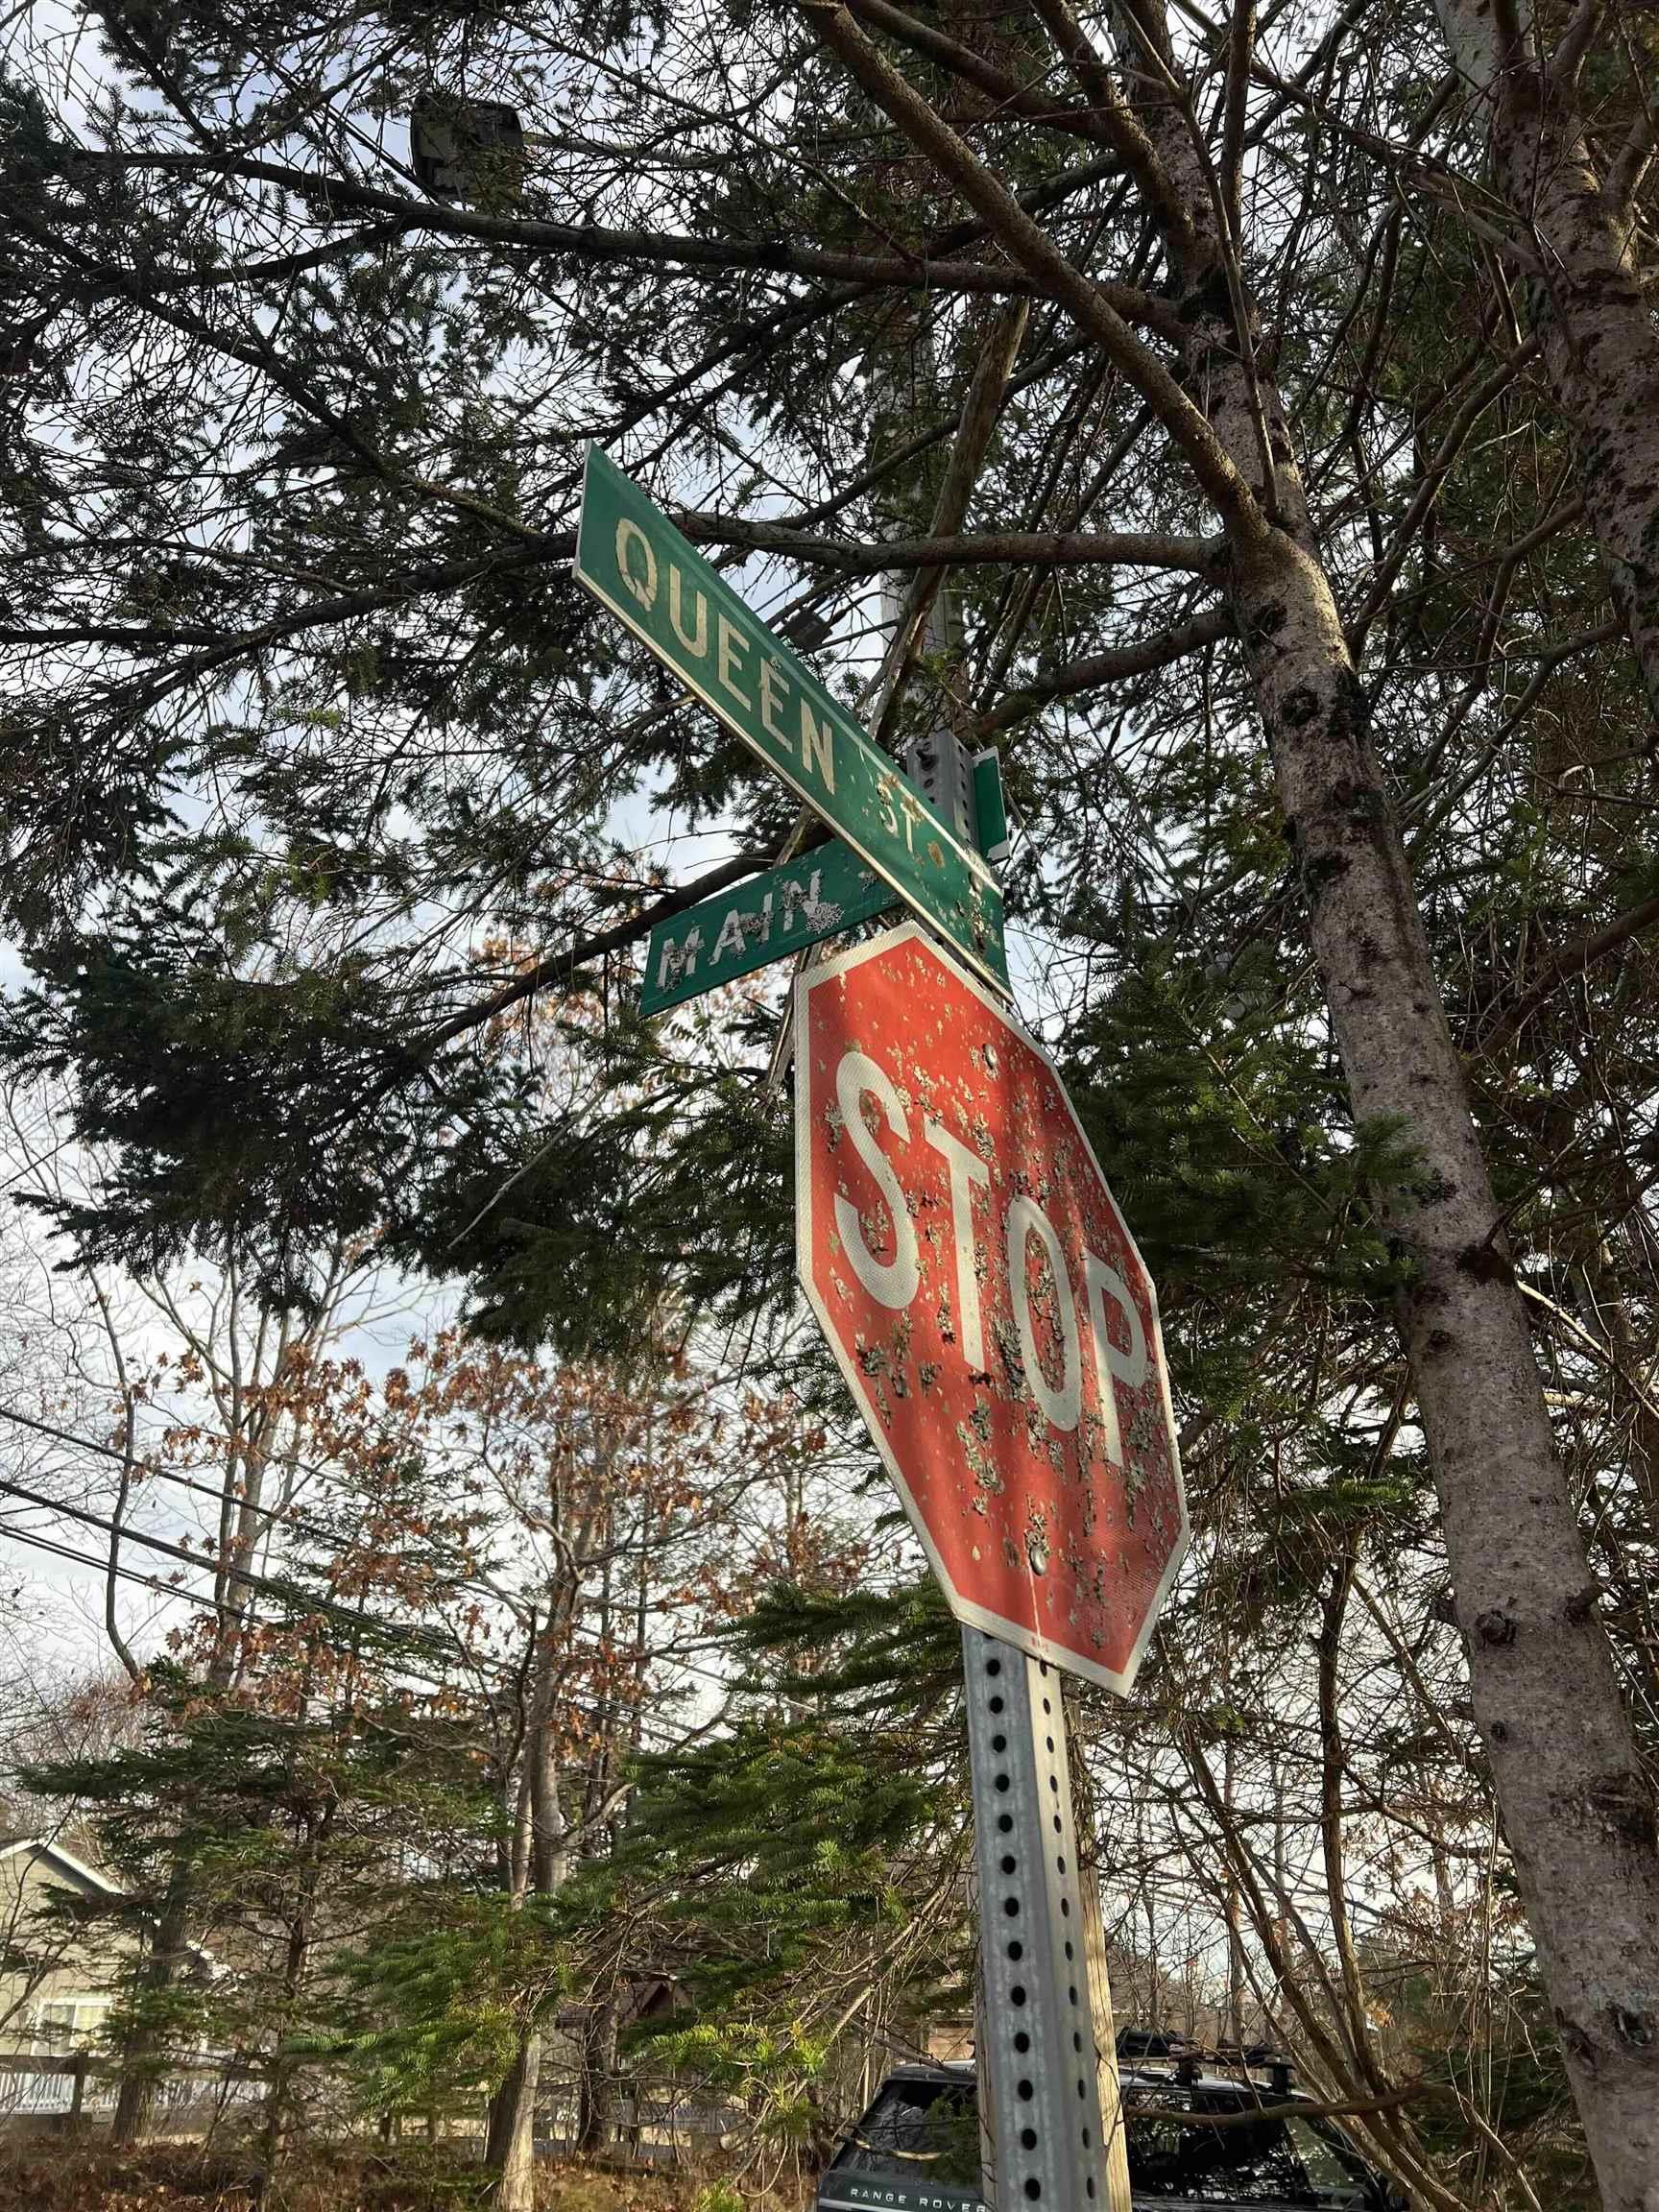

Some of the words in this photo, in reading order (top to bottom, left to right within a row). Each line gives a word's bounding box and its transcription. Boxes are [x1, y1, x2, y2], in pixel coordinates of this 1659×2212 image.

[615, 517, 834, 795] QUEEN
[876, 774, 925, 854] ST
[656, 868, 826, 993] MAIN
[834, 1050, 1147, 1468] STOP
[850, 2188, 907, 2204] RANGE
